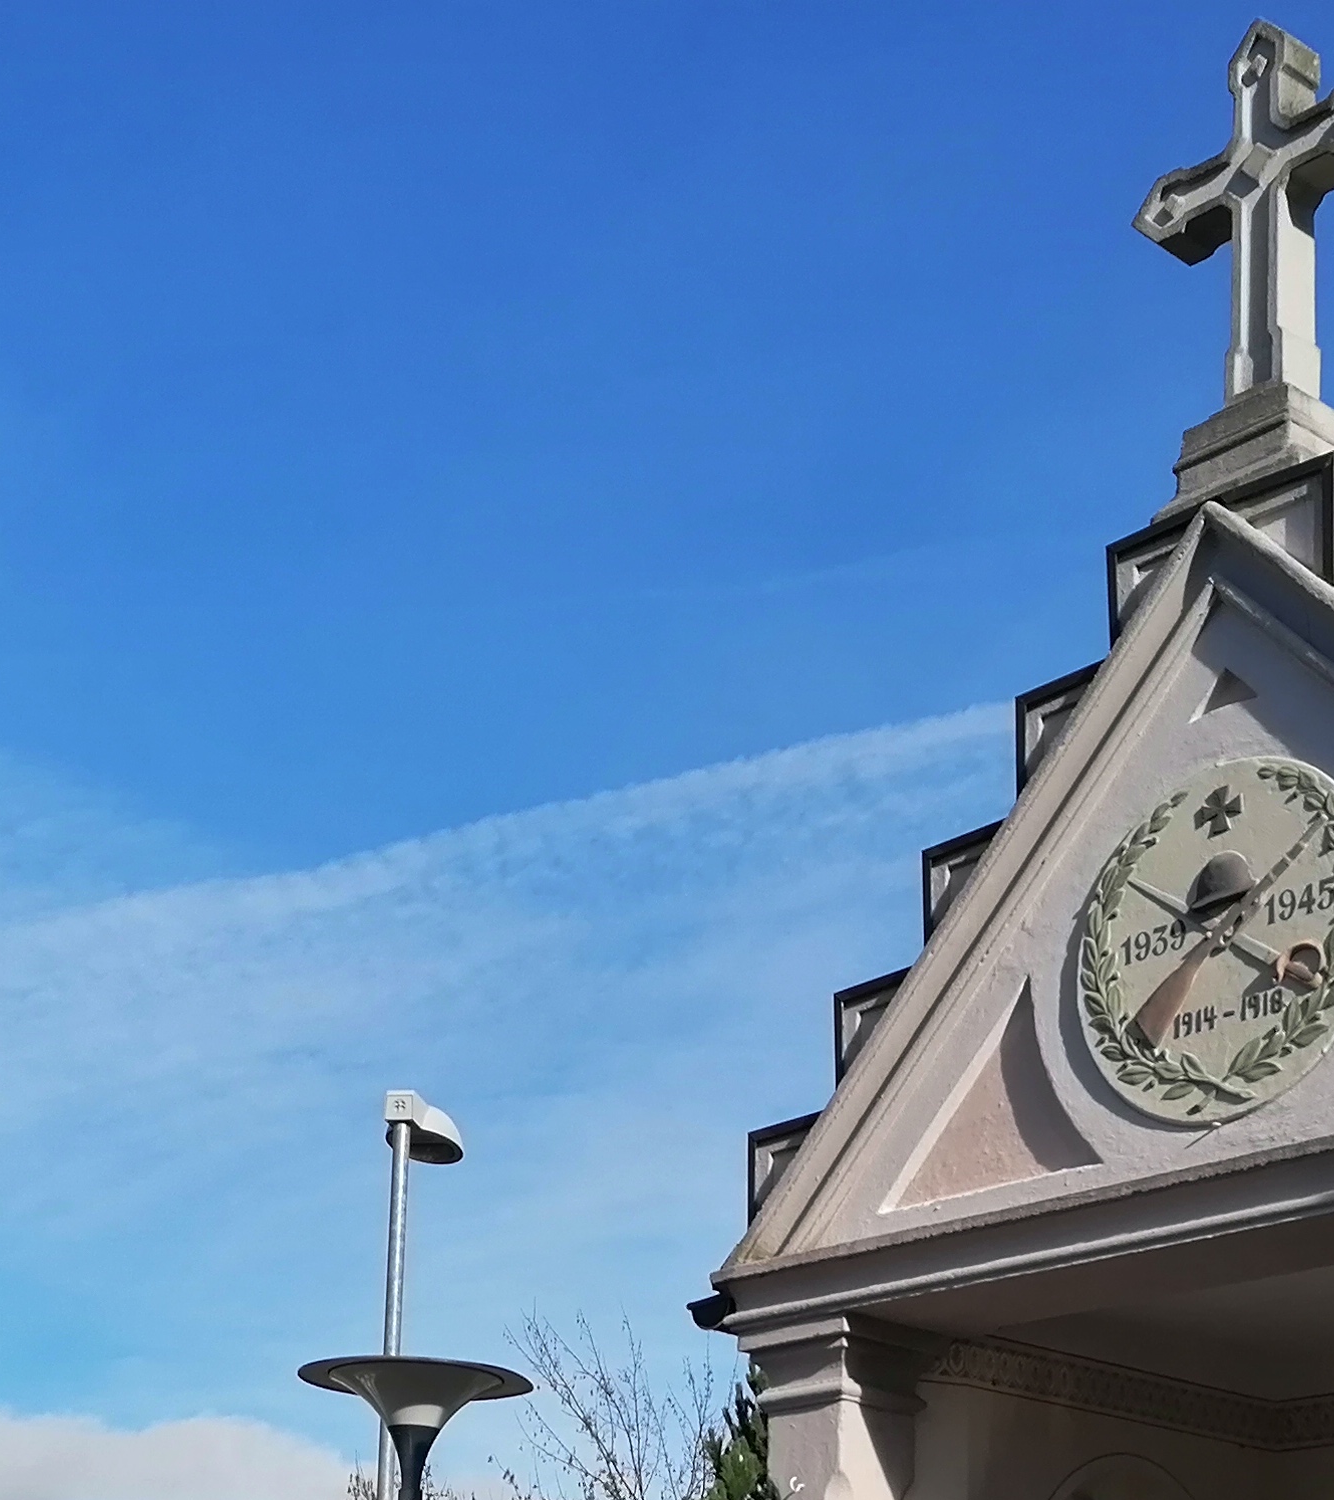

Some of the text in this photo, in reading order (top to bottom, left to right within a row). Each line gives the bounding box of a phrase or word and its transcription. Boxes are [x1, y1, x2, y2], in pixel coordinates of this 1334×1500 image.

[1120, 918, 1187, 966] 1939
[1173, 1006, 1217, 1040] 1914
[1239, 989, 1284, 1021] 1918
